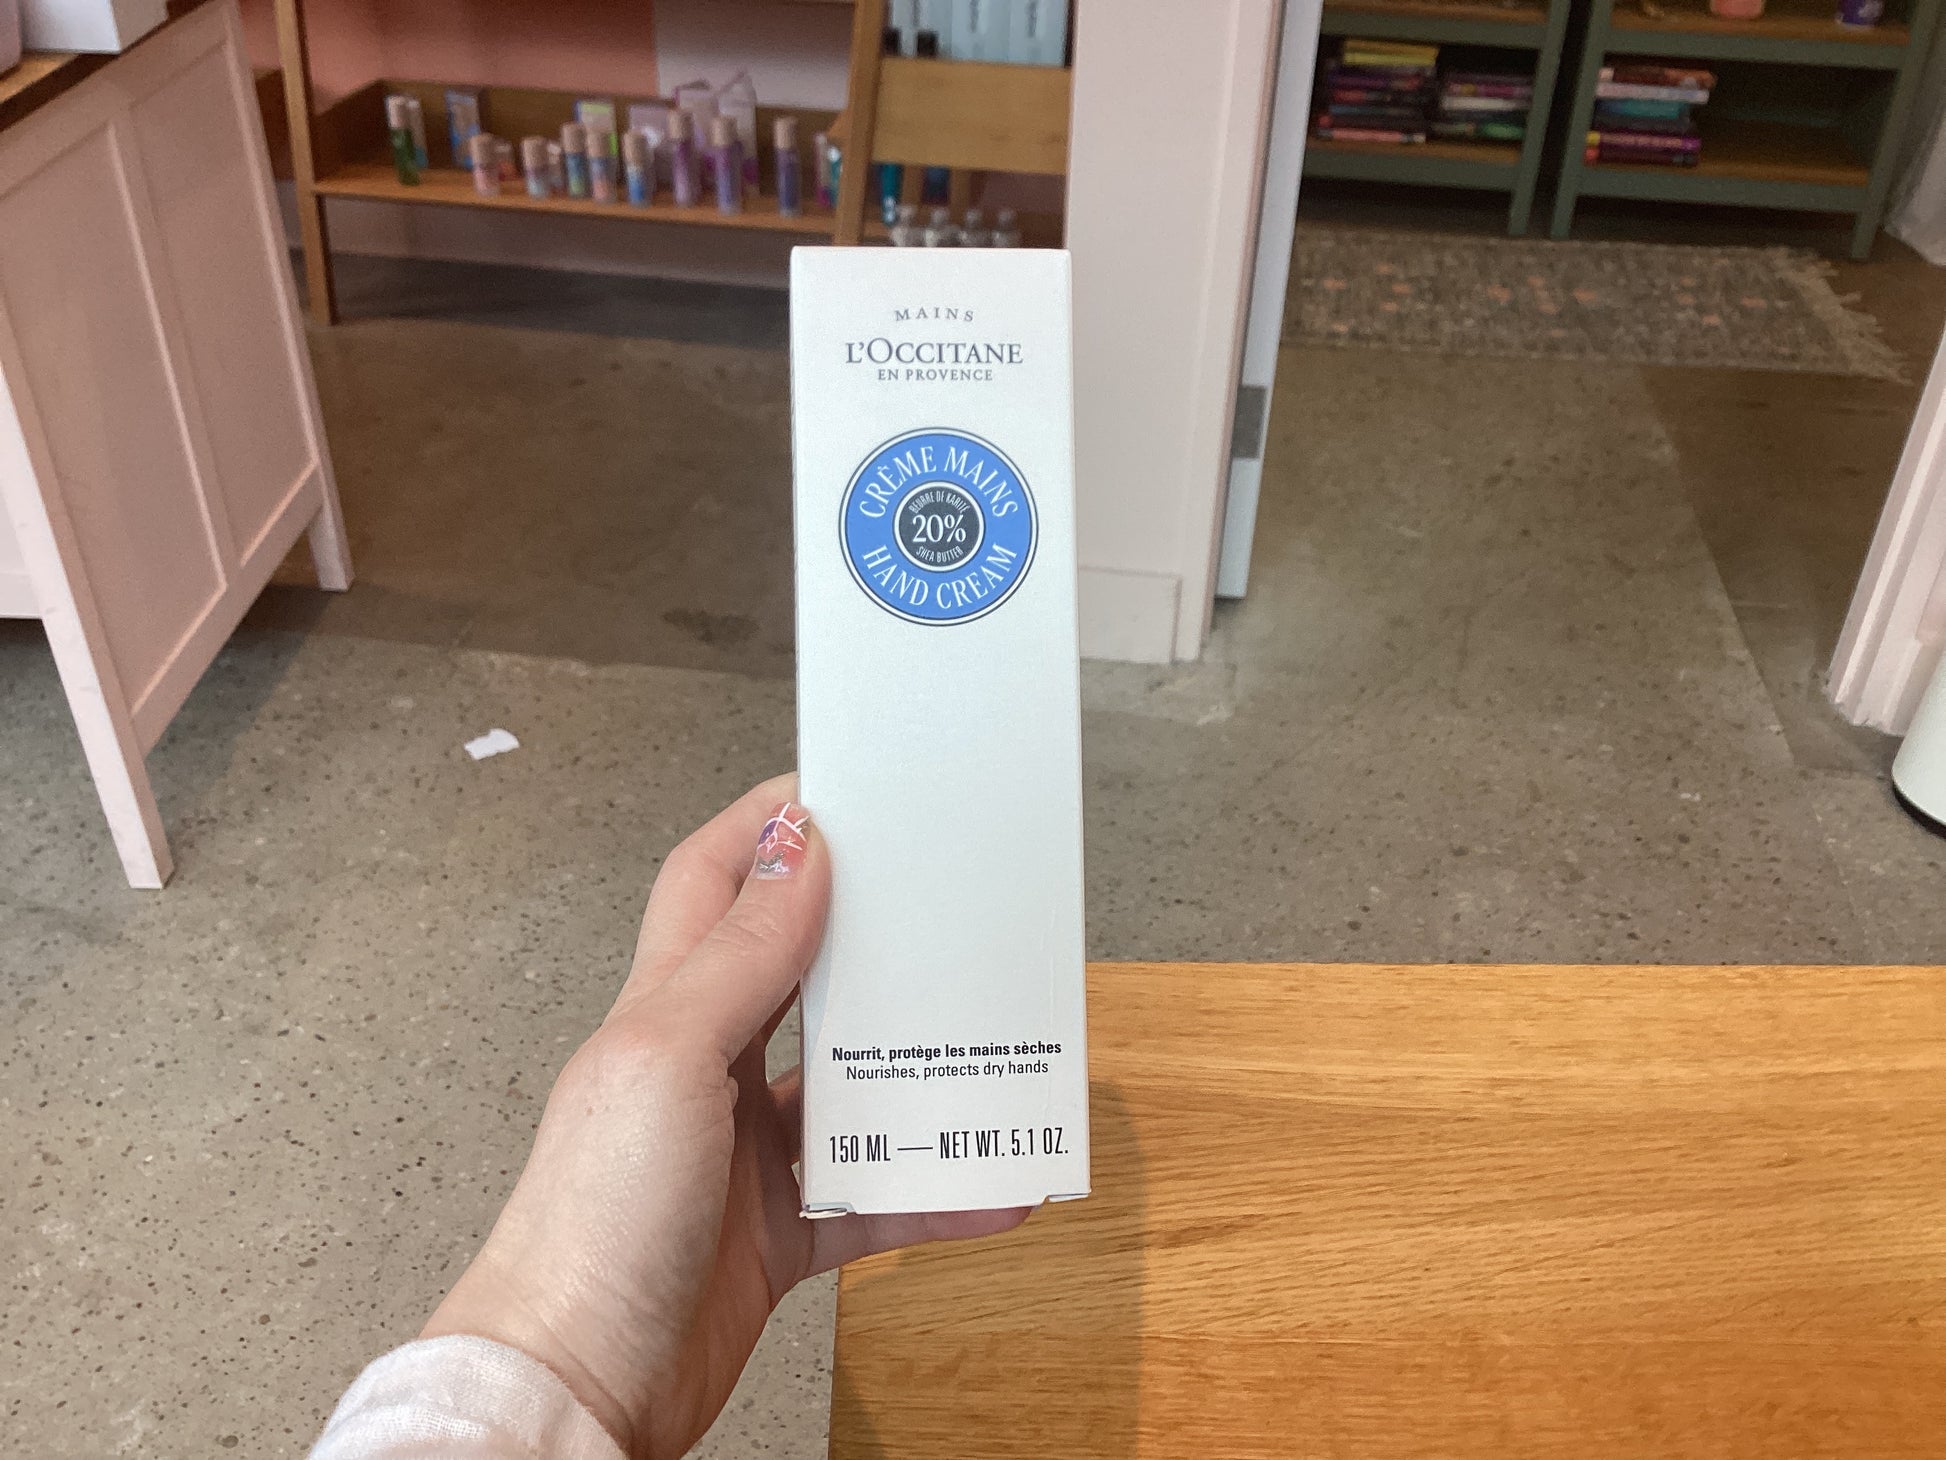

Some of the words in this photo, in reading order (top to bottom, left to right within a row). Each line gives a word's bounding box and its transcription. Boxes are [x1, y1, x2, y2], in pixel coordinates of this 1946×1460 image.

[895, 307, 974, 323] MAINS
[878, 369, 899, 381] EN
[906, 369, 993, 381] PROVENCE
[859, 446, 937, 518] CRÈME
[945, 445, 1018, 518] MAINS
[908, 491, 935, 513] BEURRE
[912, 514, 967, 543] 20%
[916, 546, 934, 562] SHEA
[936, 546, 964, 563] BUTTER
[862, 544, 928, 606] HAND
[936, 544, 1018, 609] CREAM
[832, 1046, 885, 1061] Nourrit,
[889, 1044, 941, 1062] protège
[946, 1043, 965, 1057] les
[969, 1045, 1010, 1056] mains
[1014, 1041, 1061, 1054] sèches
[846, 1066, 920, 1080] Nourishes,
[924, 1064, 979, 1079] protects
[983, 1062, 1004, 1077] dry
[1008, 1060, 1048, 1074] hands
[829, 1135, 859, 1163] 150
[866, 1134, 890, 1162] ML
[940, 1131, 969, 1159] NET
[976, 1129, 1005, 1157] WT.
[1012, 1128, 1034, 1156] 5.1
[1043, 1127, 1069, 1154] OZ.
